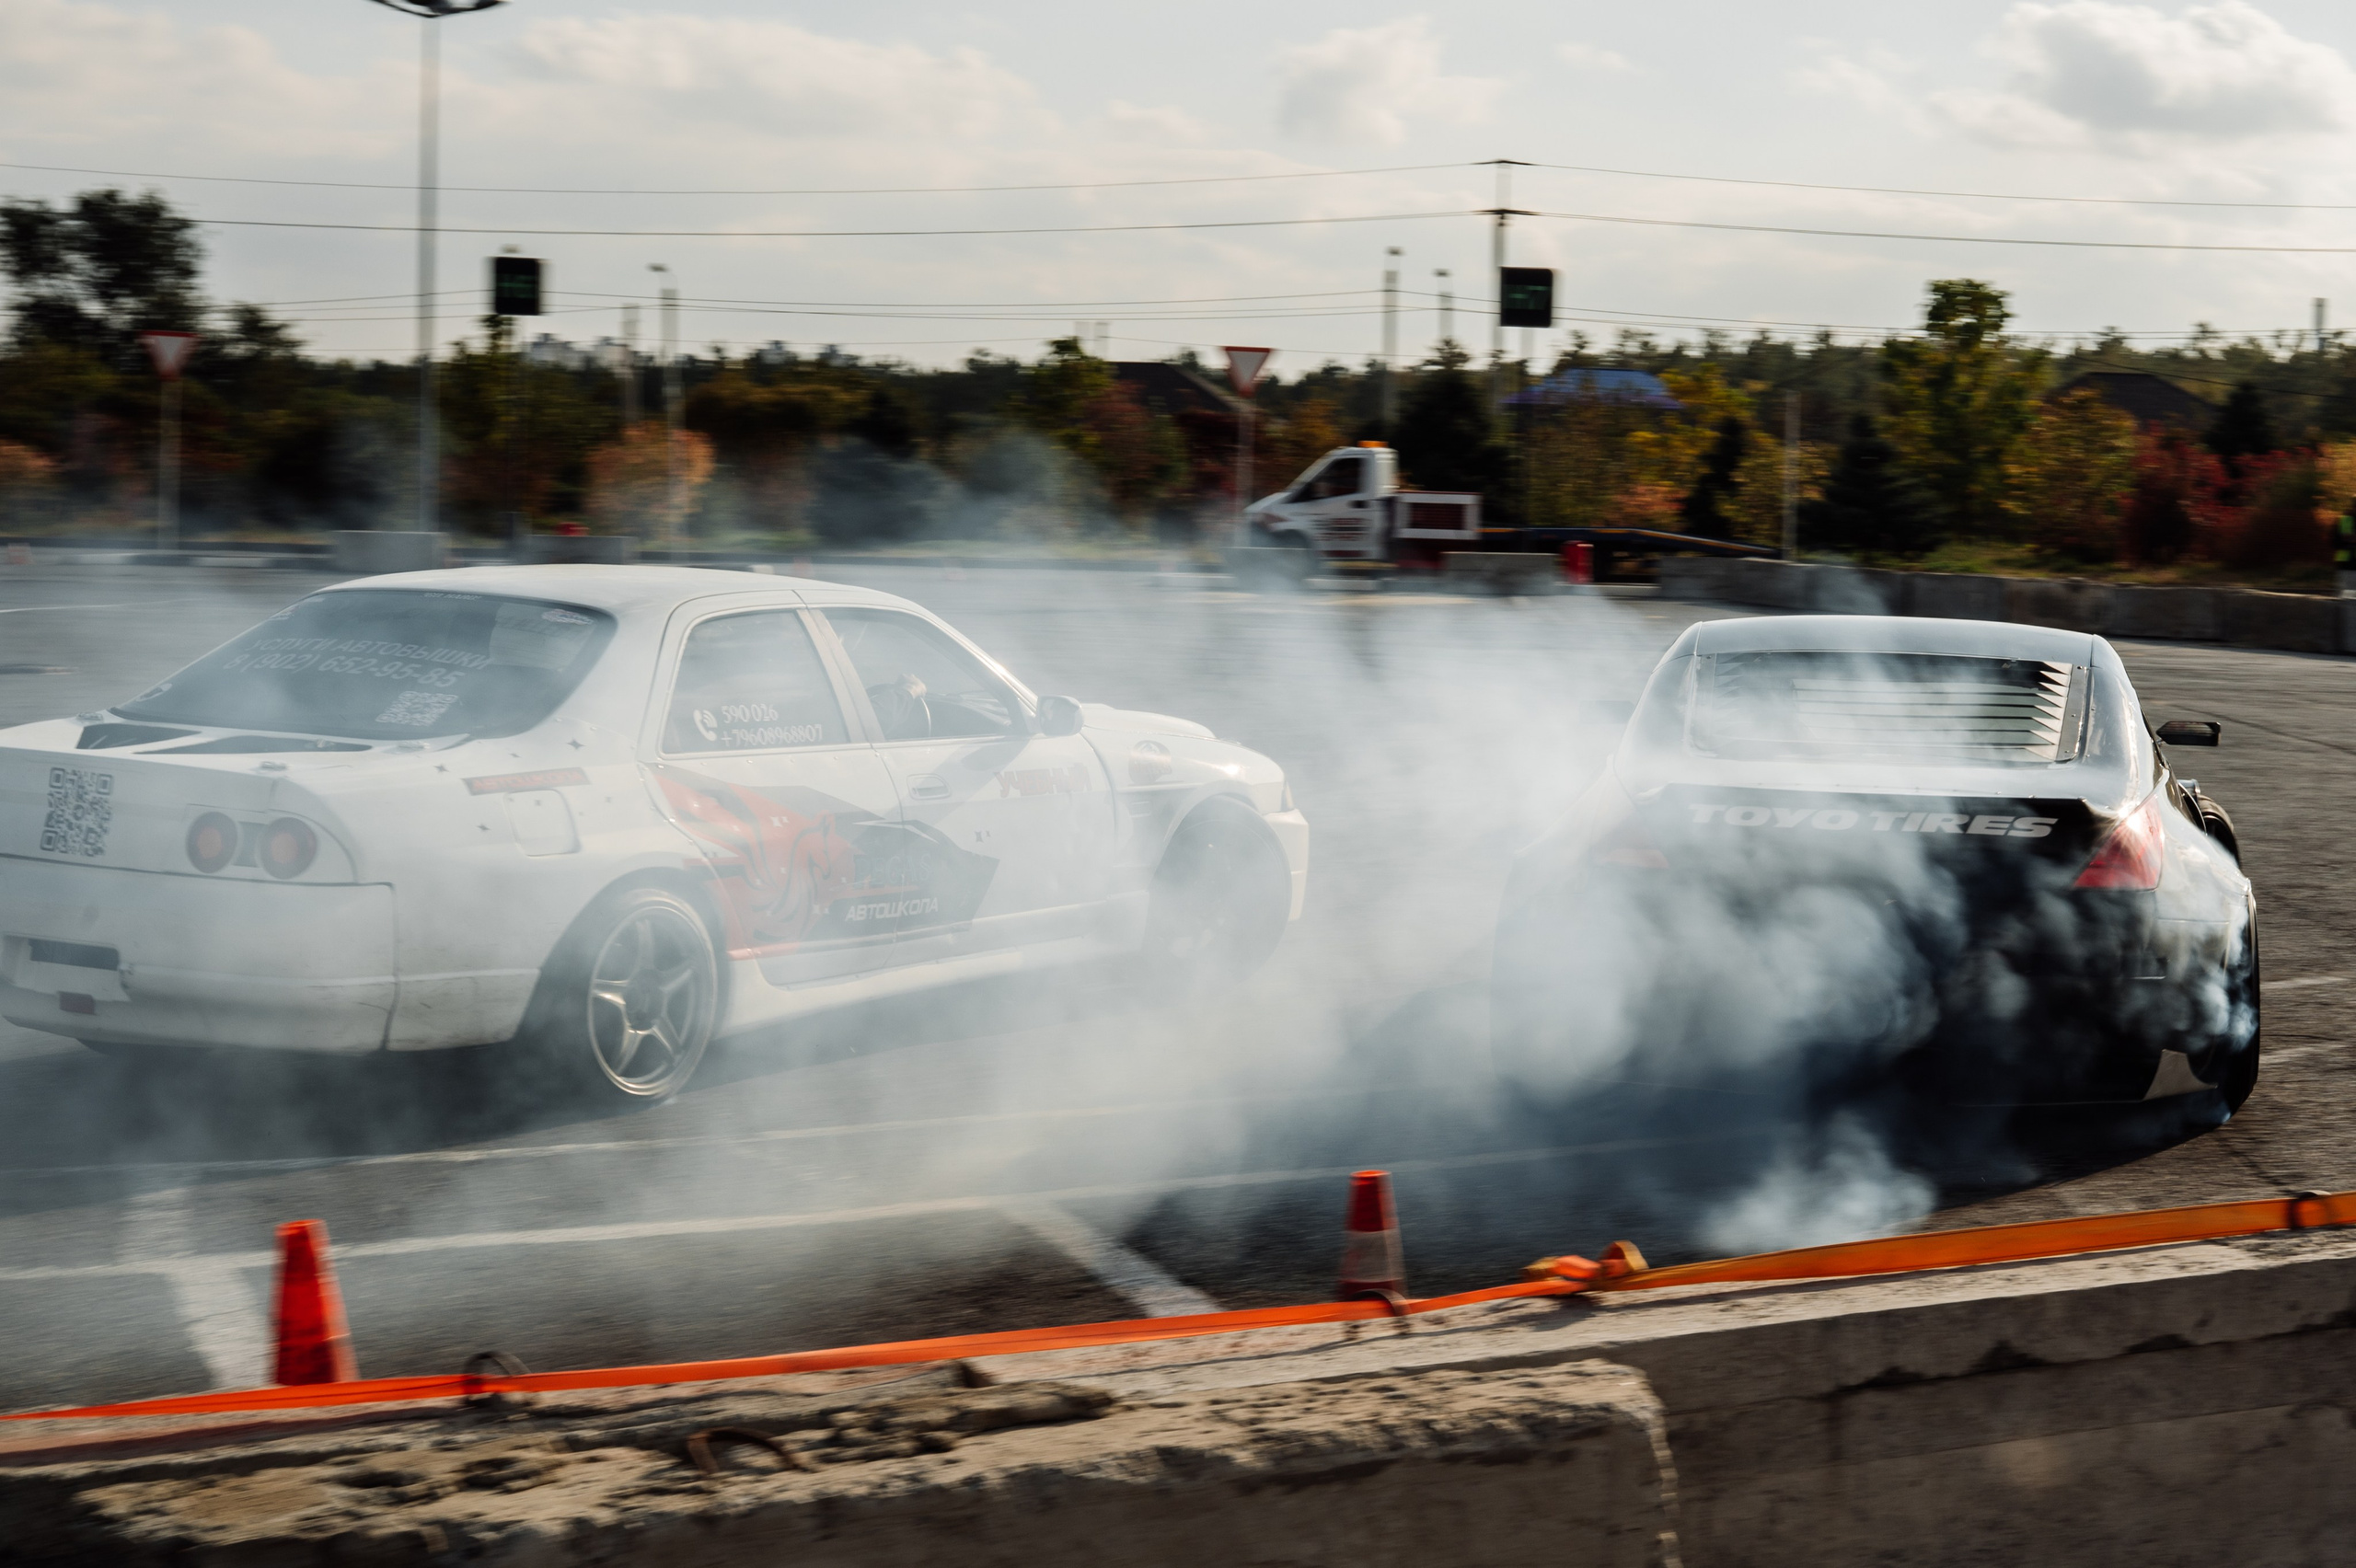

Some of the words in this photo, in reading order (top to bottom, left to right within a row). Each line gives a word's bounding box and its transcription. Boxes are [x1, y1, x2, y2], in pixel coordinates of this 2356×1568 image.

[241, 652, 320, 674] (902)
[318, 655, 467, 688] 652-95-85
[247, 638, 337, 651] УСЛУГИ
[330, 639, 492, 670] АВТОВЫШКИ
[1689, 804, 1859, 831] TOYO
[1868, 810, 2060, 838] TIRES
[845, 897, 939, 922] АВТОШКОЛА
